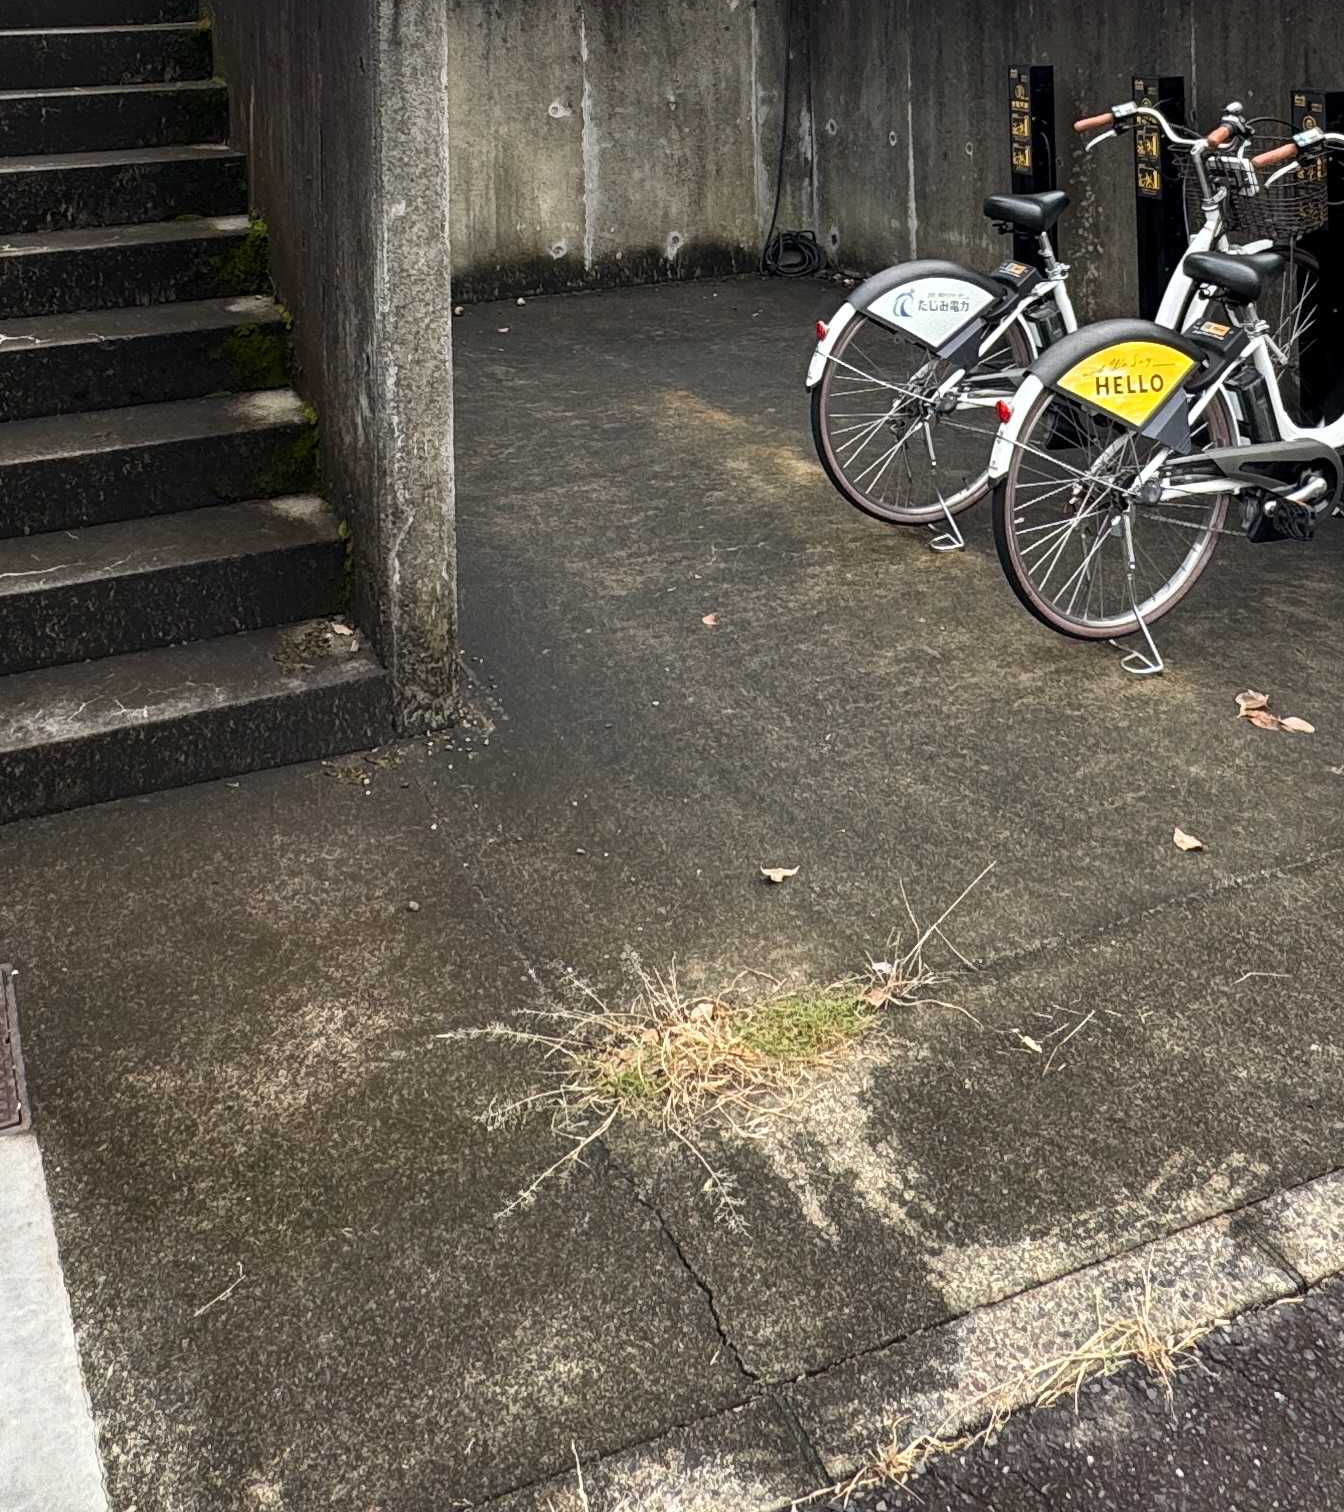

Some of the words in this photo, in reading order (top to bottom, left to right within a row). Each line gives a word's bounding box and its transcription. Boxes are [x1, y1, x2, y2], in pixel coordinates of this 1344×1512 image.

[918, 299, 970, 313] たじみ電力
[1095, 373, 1164, 395] HELLO
